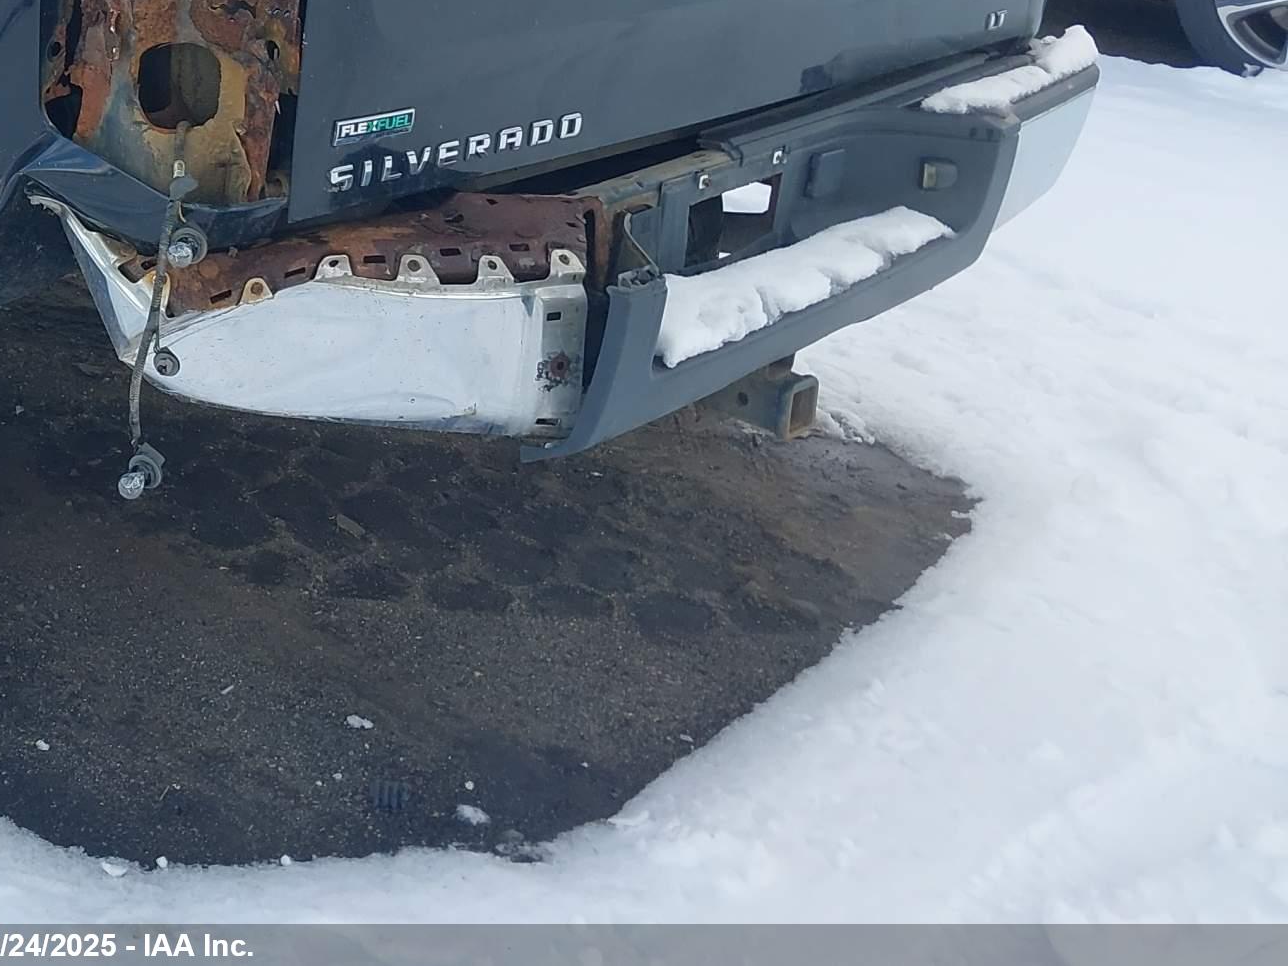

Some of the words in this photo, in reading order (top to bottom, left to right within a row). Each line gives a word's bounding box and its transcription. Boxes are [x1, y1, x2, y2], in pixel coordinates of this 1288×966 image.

[987, 9, 1009, 31] LT
[340, 114, 413, 139] FLEXFUEL
[328, 111, 584, 193] SILVERADO
